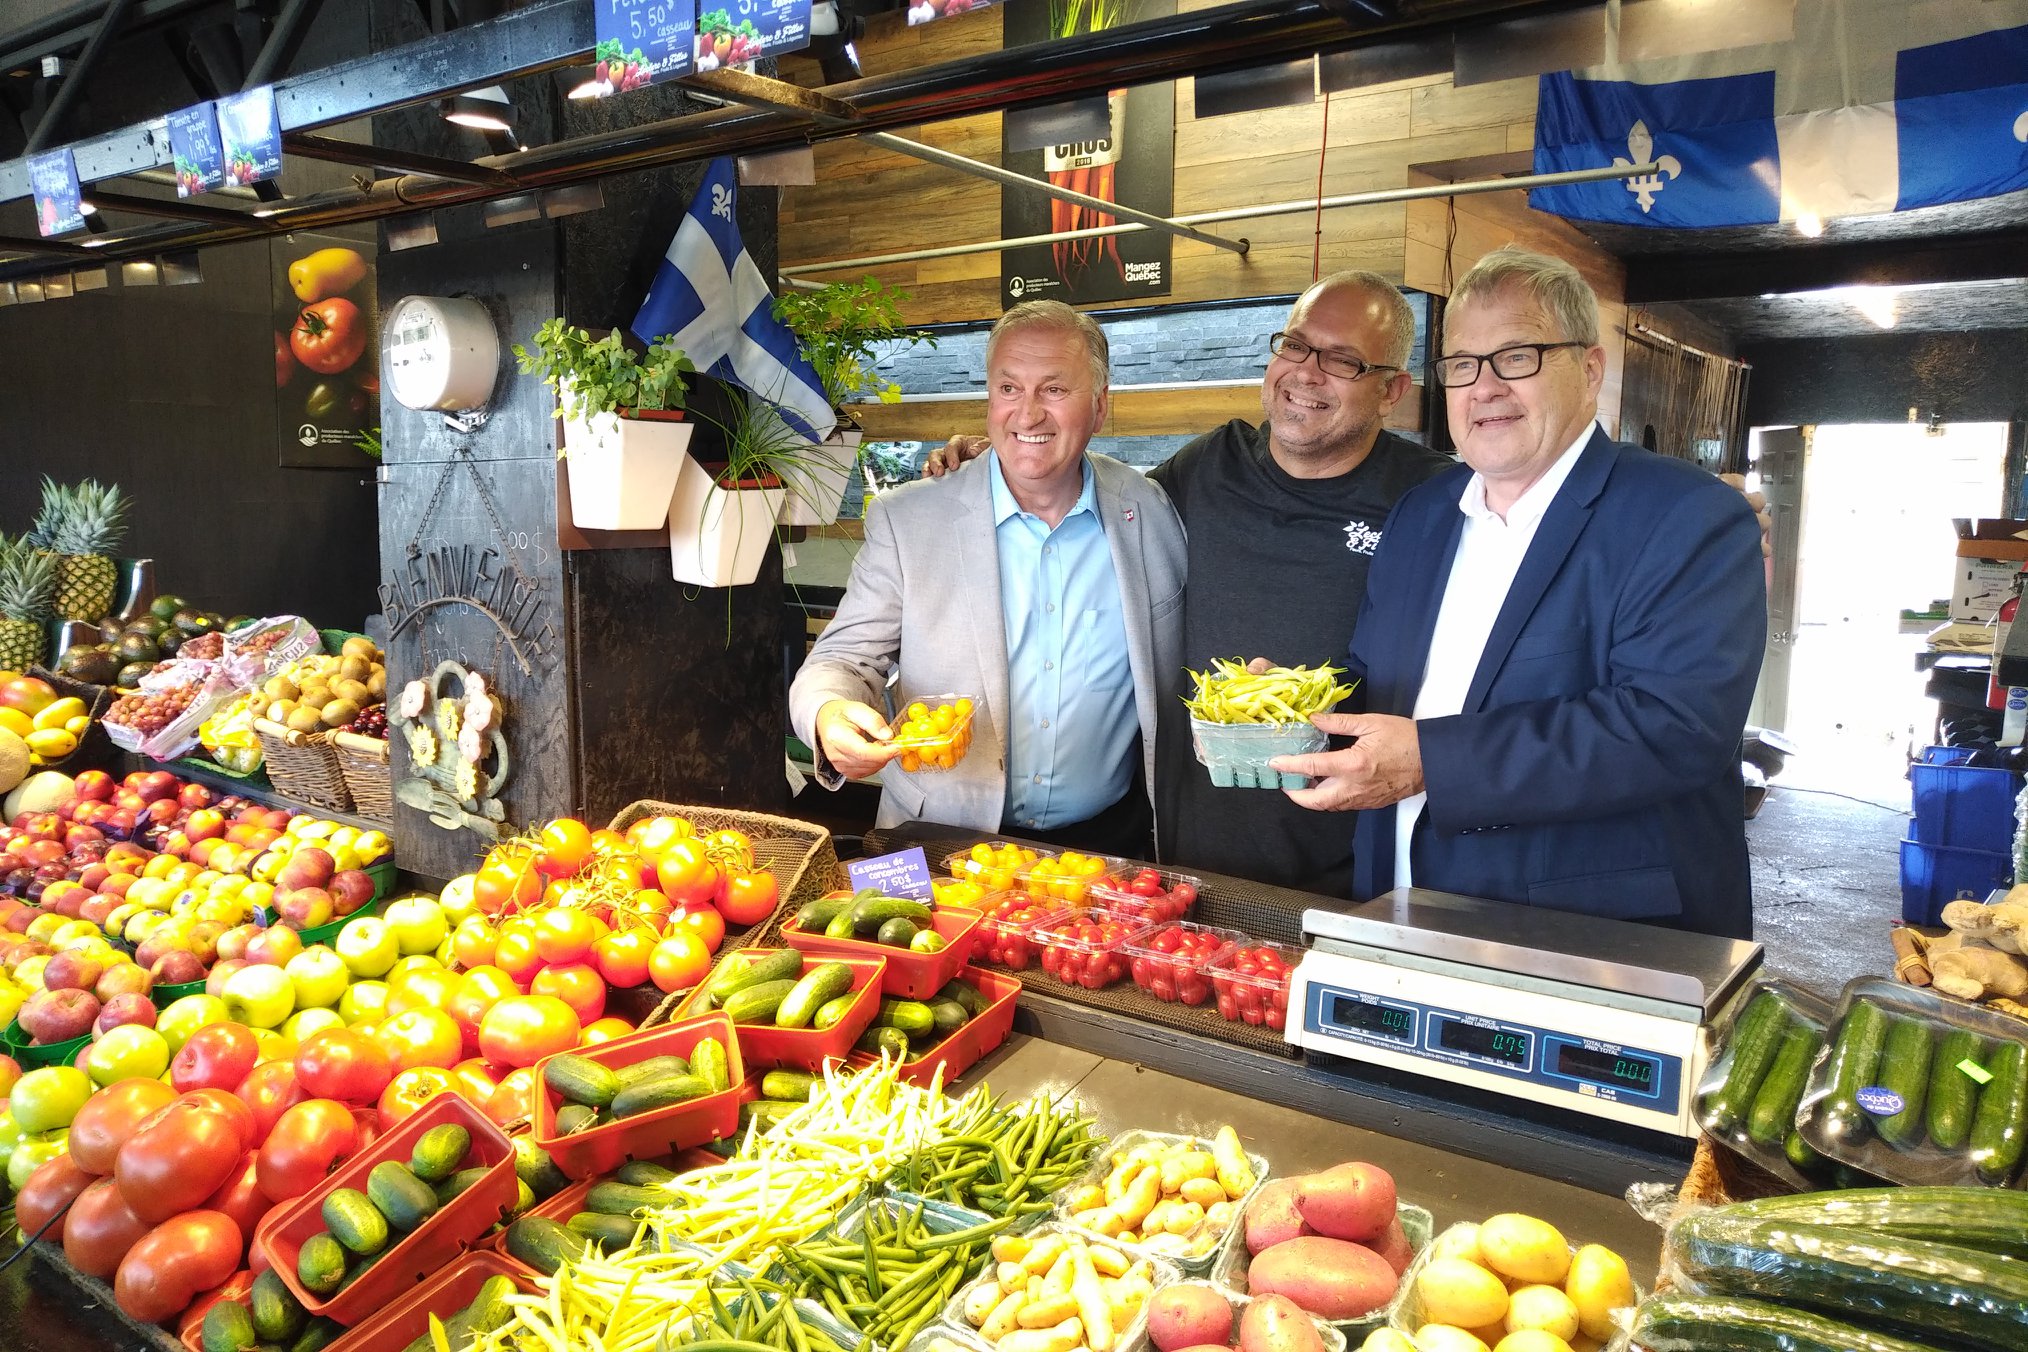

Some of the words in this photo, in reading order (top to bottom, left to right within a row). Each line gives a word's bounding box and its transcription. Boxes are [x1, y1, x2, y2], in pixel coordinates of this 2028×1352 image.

[657, 19, 693, 37] casseau
[1125, 262, 1161, 273] Mangez
[1125, 270, 1161, 282] Québec
[377, 543, 556, 668] BIENVENUE
[851, 861, 891, 876] Casseau
[892, 857, 904, 866] de
[1359, 992, 1380, 1001] WEIGHT
[1361, 997, 1378, 1006] POIDS
[1460, 1018, 1474, 1026] PRIX
[1474, 1021, 1500, 1031] UNITAIRE
[1465, 1014, 1478, 1022] UNIT
[1479, 1017, 1497, 1026] PRICE
[1492, 1034, 1525, 1055] 0.75
[1583, 1038, 1602, 1047] TOTAL
[1603, 1042, 1622, 1051] PRICE
[1584, 1044, 1599, 1052] PRIX
[1600, 1047, 1619, 1056] TOTAL
[1858, 1093, 1902, 1109] Québec
